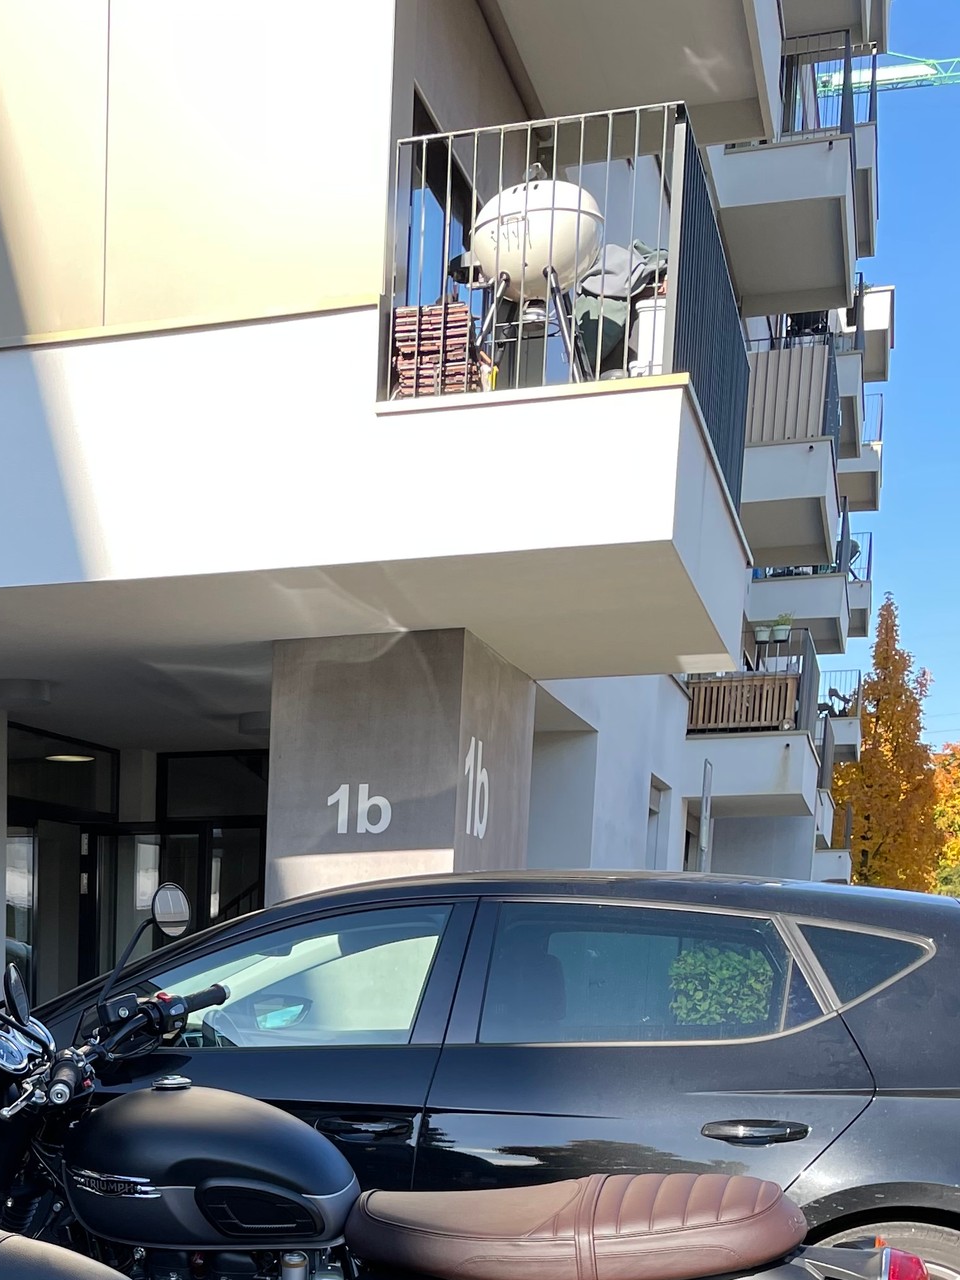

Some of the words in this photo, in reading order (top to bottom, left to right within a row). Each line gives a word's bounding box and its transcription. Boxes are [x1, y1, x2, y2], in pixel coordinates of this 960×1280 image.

[327, 783, 392, 834] 1b
[464, 736, 489, 840] 1b
[83, 1178, 134, 1193] TRIUMPH
